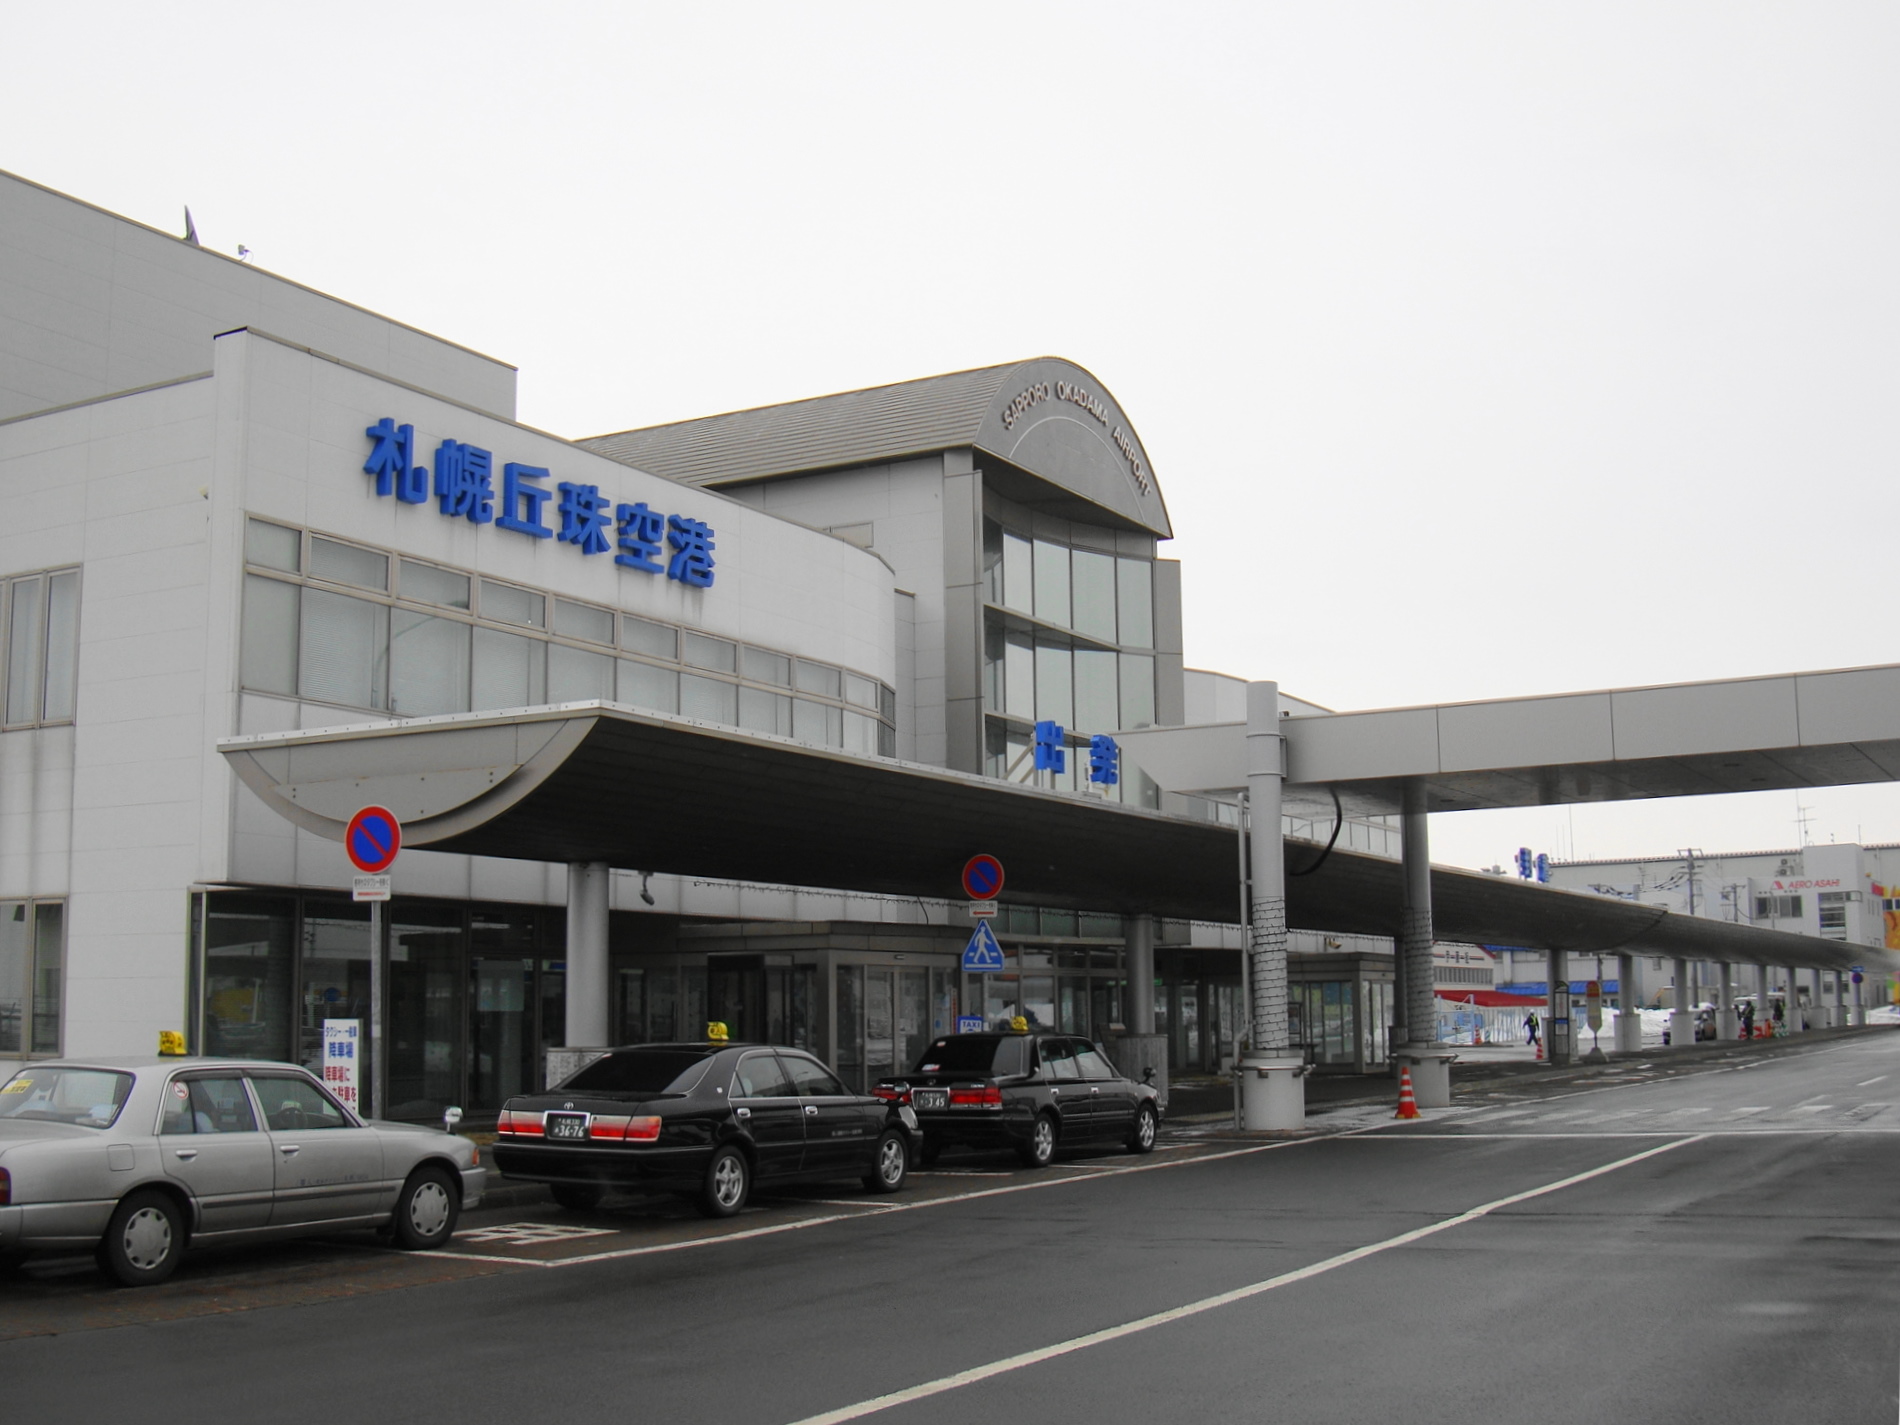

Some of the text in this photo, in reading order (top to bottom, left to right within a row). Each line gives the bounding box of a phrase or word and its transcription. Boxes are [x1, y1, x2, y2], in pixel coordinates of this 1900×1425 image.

[1003, 380, 1152, 497] SAPPORO OKADAMA AIRPORT
[363, 417, 716, 588] 札幌丘珠空港
[1788, 879, 1841, 889] AERO ASAHI
